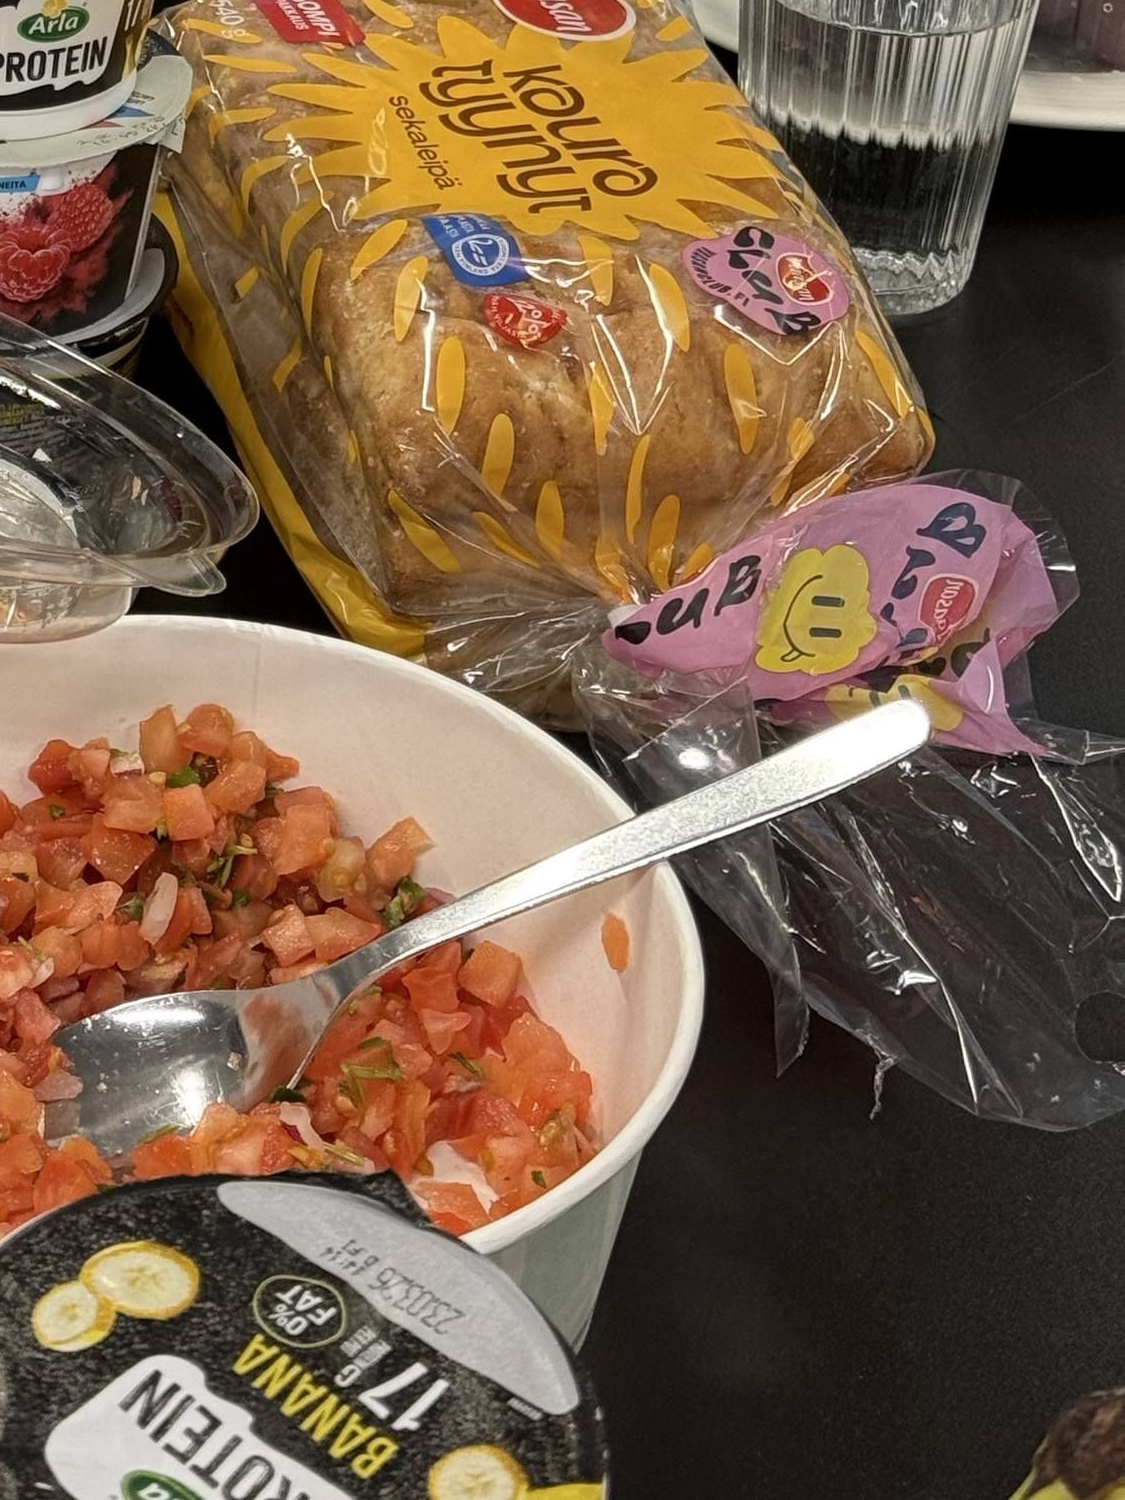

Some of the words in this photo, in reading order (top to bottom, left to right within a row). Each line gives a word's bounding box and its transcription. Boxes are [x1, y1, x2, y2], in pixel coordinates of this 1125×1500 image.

[28, 7, 80, 36] Arla
[208, 0, 245, 27] 540
[389, 94, 463, 191] sekaleipä
[419, 59, 592, 214] tyynyt
[267, 1303, 309, 1336] 0%
[276, 1284, 338, 1327] FAT
[229, 1334, 401, 1480] BANANA
[357, 1361, 454, 1433] 17
